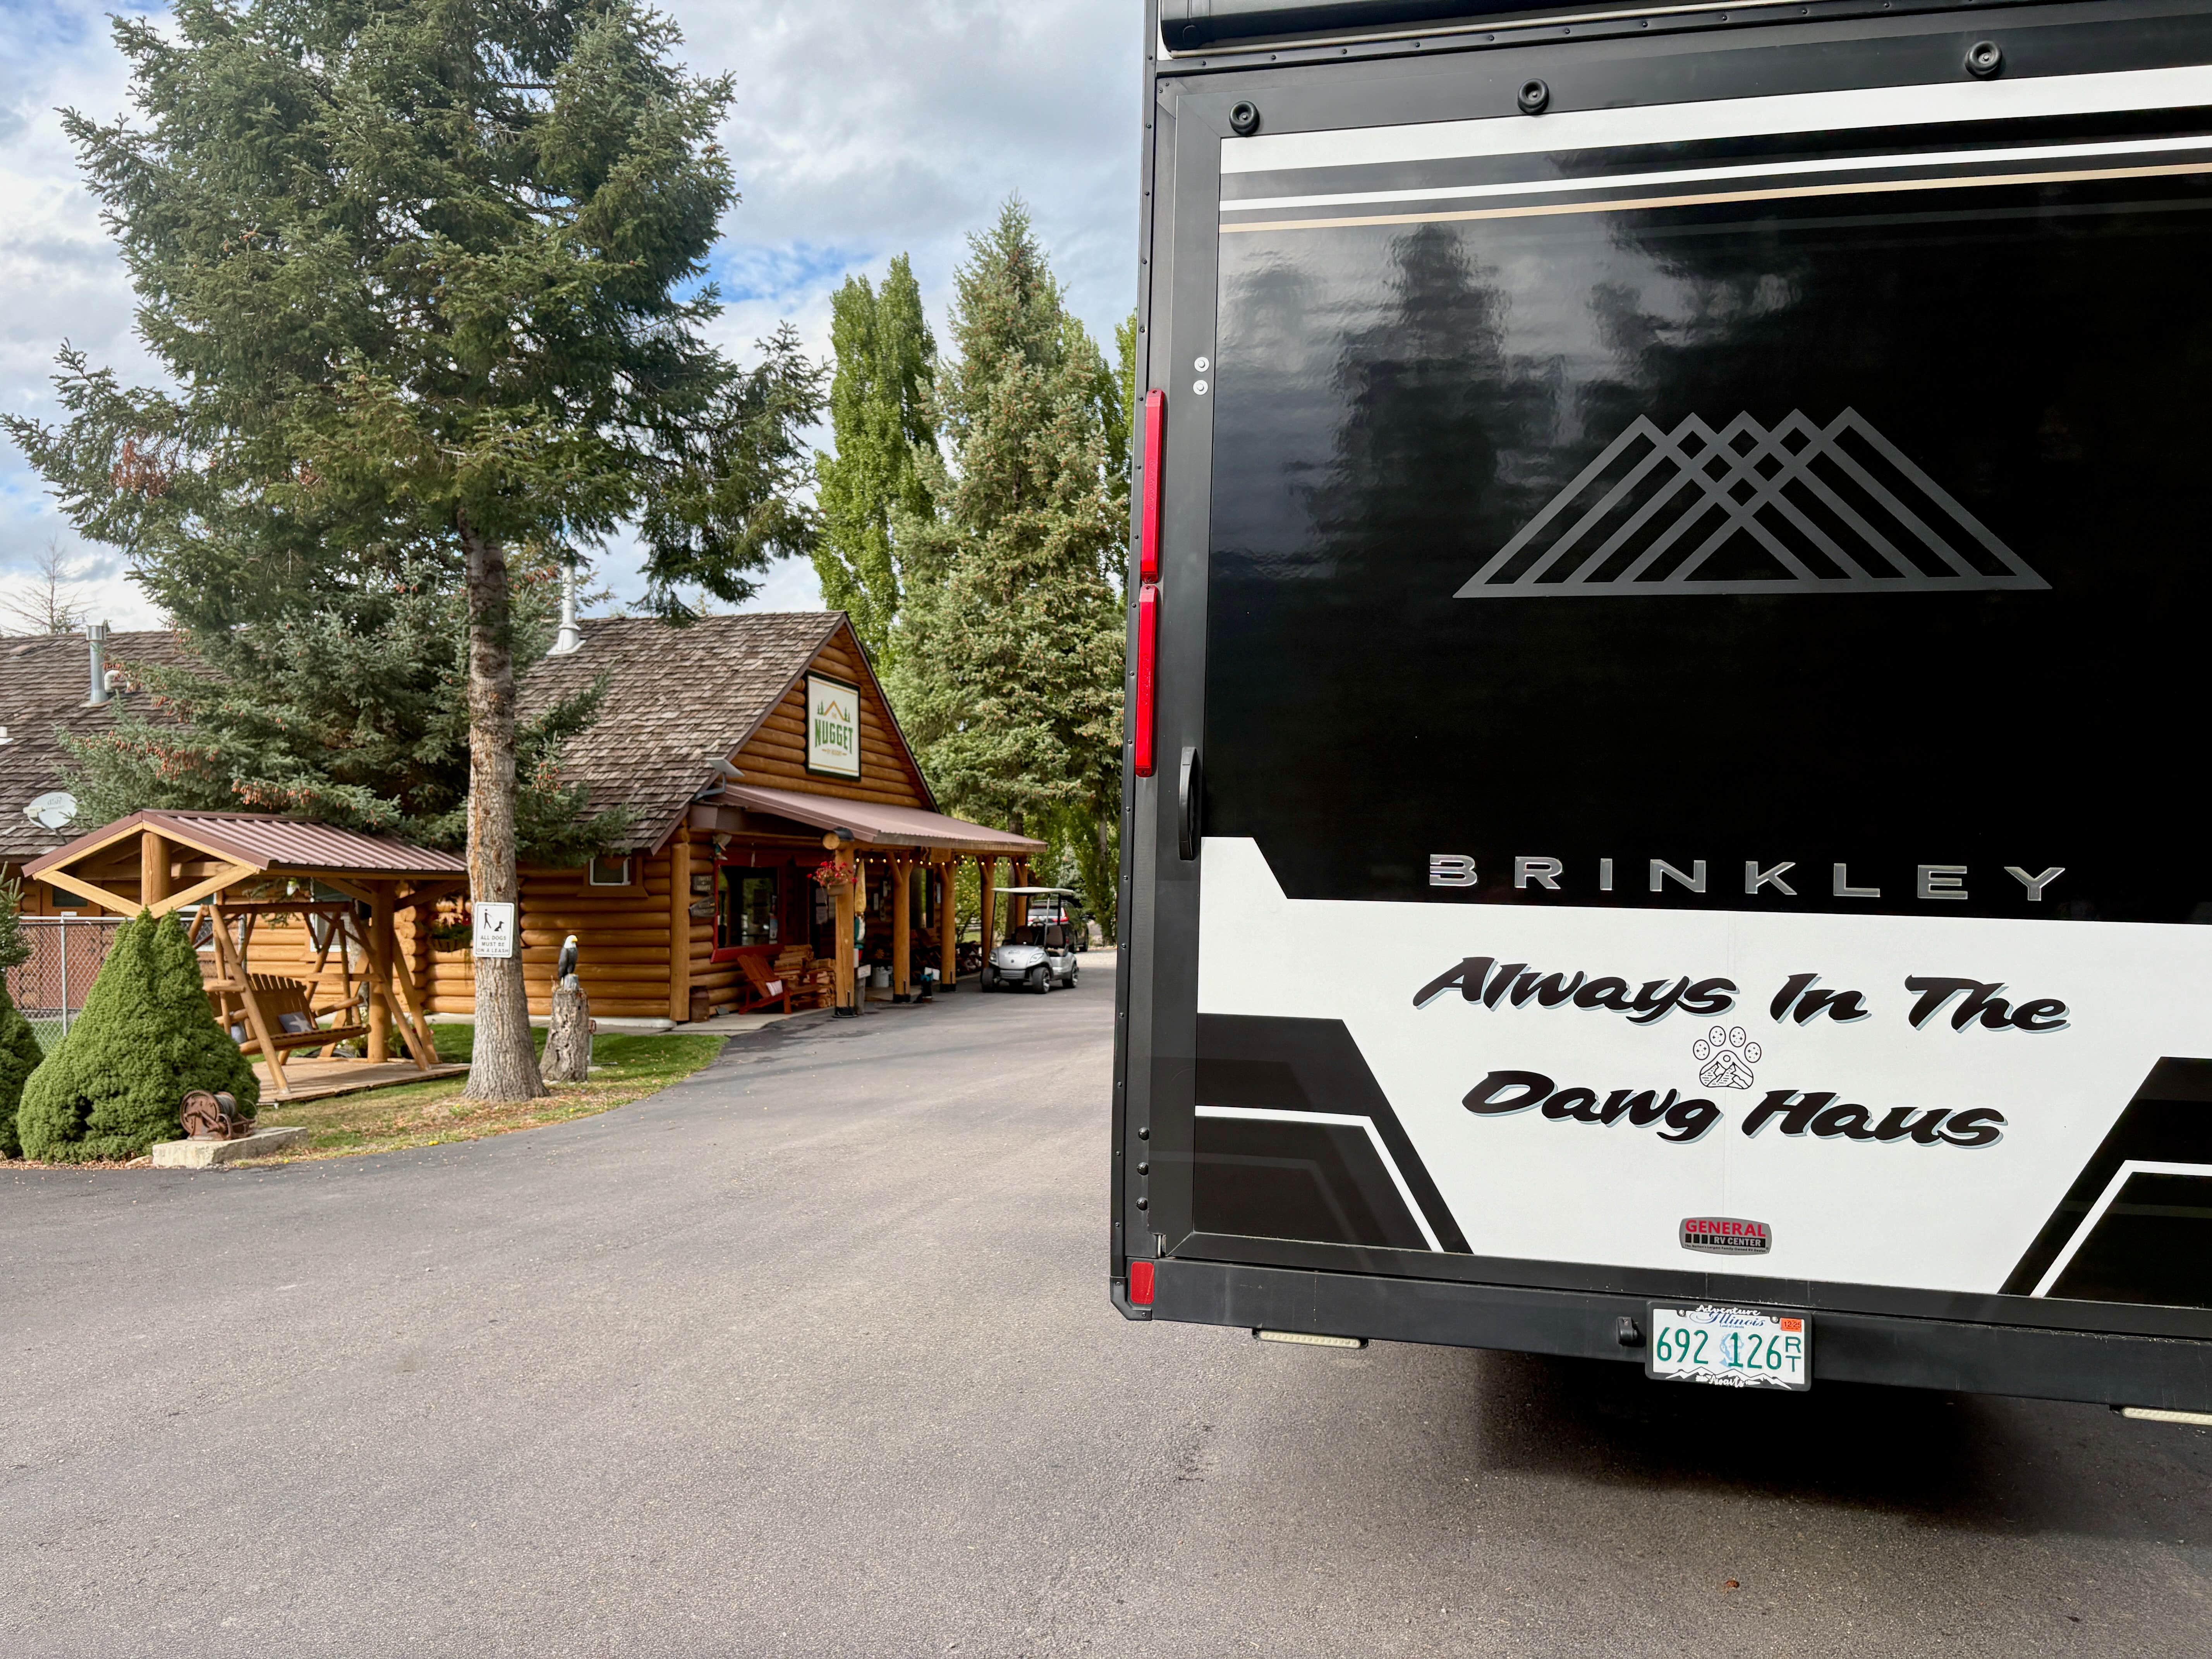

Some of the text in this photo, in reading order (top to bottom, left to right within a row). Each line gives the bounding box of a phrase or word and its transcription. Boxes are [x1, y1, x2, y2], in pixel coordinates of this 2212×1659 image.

[815, 718, 853, 754] NUGGET
[1429, 854, 2066, 902] BRINKLEY
[1413, 957, 2071, 1034] Always In The
[1462, 1070, 2009, 1150] Dawg Haus
[1685, 1219, 1766, 1237] GENERAL
[1728, 1238, 1761, 1247] CENTER
[1690, 1312, 1765, 1327] Illinois
[1696, 1305, 1761, 1316] Adventure
[1657, 1327, 1782, 1370] 692 126
[1708, 1374, 1745, 1388] Awaits
